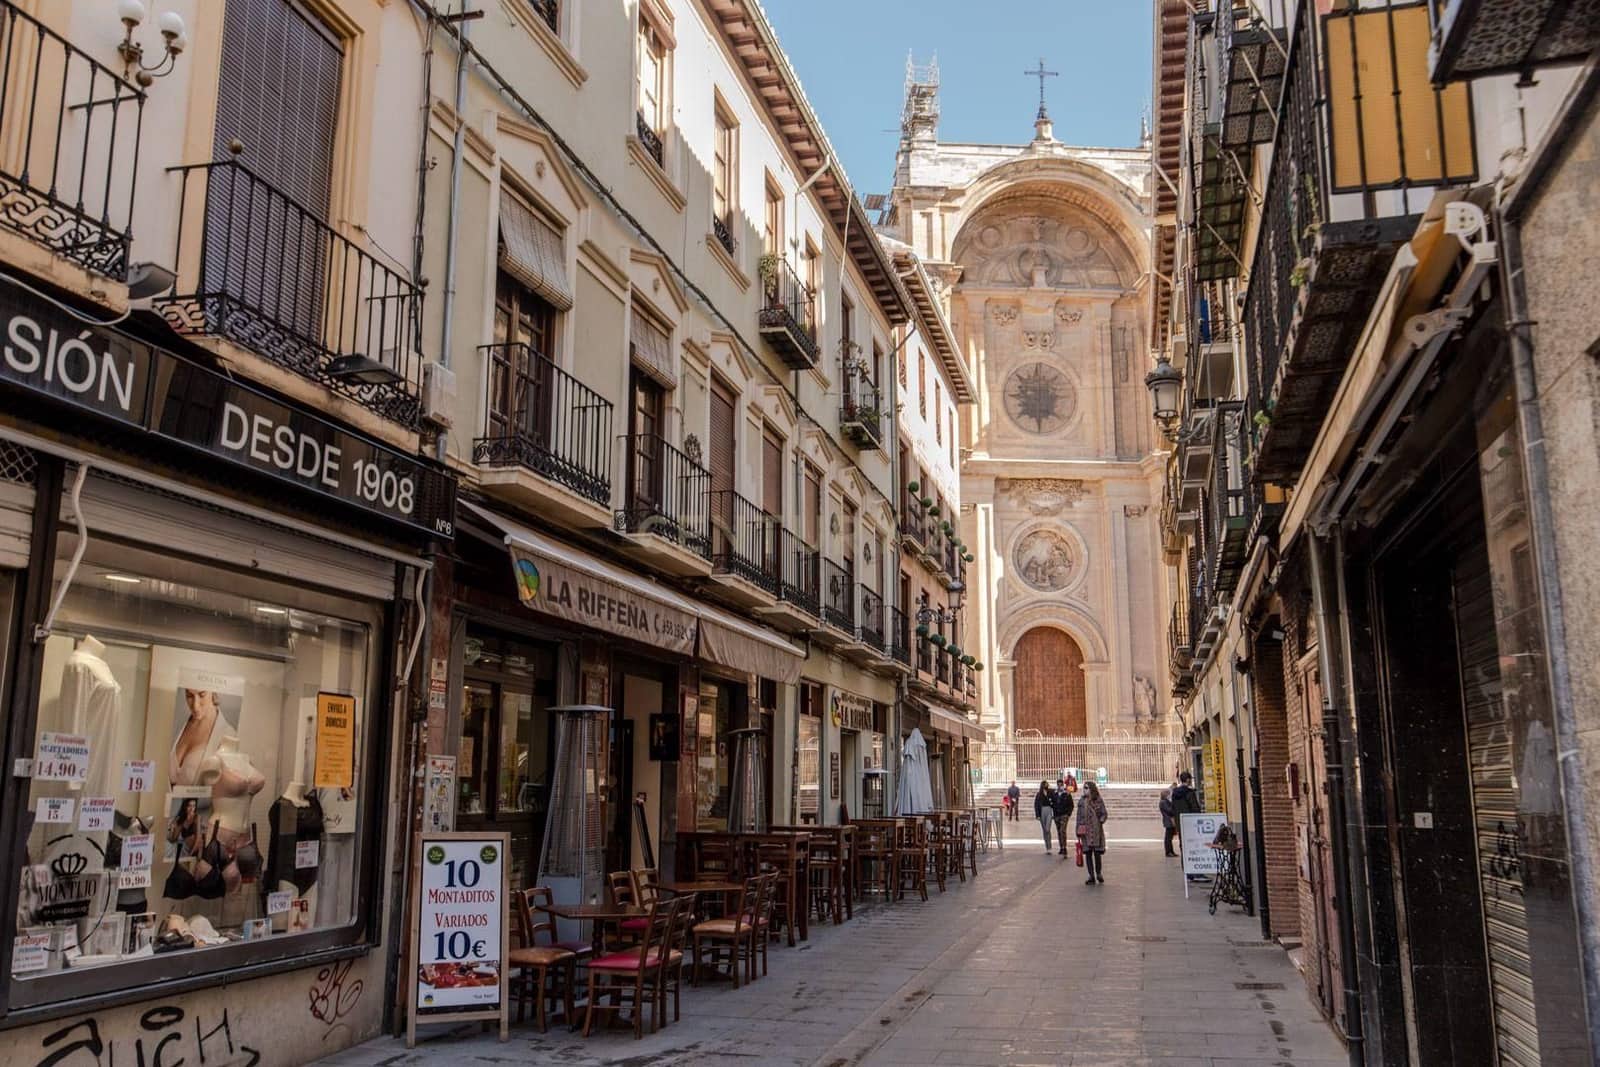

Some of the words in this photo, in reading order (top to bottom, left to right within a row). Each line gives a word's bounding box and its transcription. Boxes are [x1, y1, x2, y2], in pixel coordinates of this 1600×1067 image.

[4, 315, 135, 411] SIÓN
[220, 402, 342, 489] DESDE
[352, 459, 415, 515] 1908
[546, 575, 572, 609] LA
[578, 586, 649, 632] RIFFEÑA
[128, 777, 143, 791] 19
[128, 851, 143, 866] 19
[444, 859, 480, 888] 10
[428, 888, 495, 904] MONTADITOS
[435, 912, 488, 928] VARIADOS
[433, 930, 487, 960] 10€
